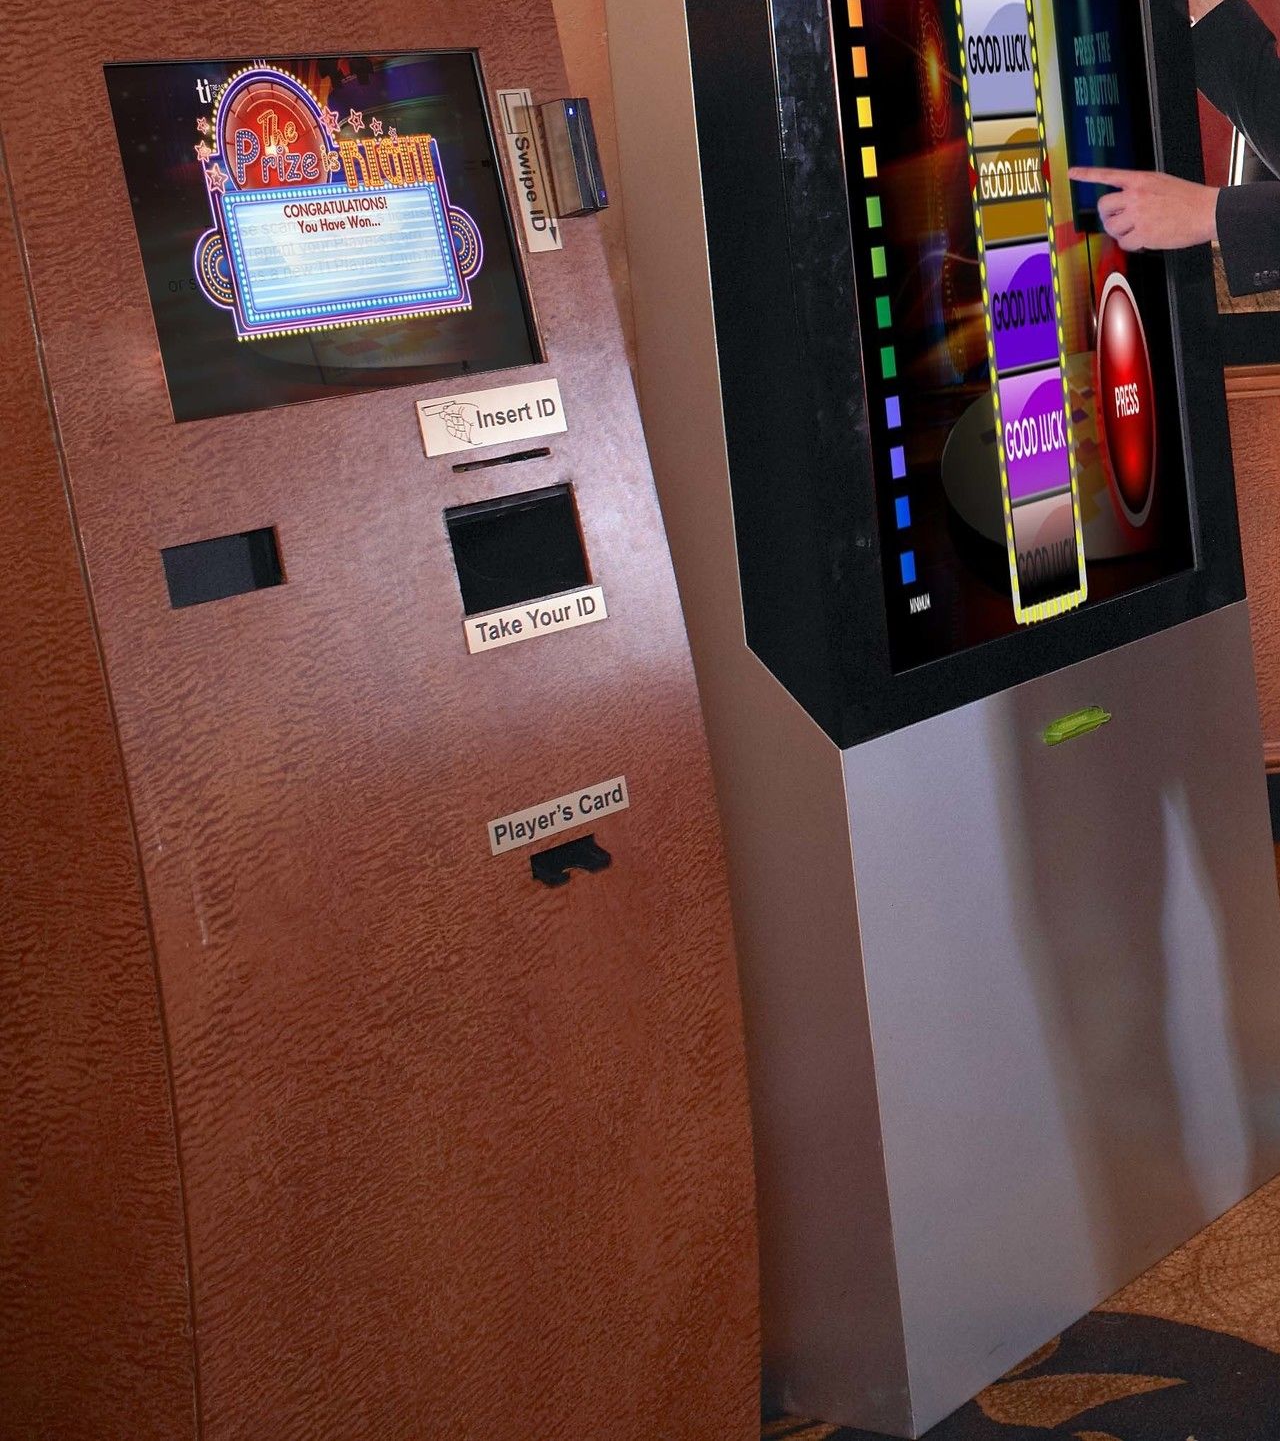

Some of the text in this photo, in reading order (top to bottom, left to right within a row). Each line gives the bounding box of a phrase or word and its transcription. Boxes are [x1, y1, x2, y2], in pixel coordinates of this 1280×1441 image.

[968, 34, 1030, 75] GOOD LUCK
[1074, 31, 1112, 67] PRESS THE
[1074, 73, 1120, 106] RED BUTTON
[257, 110, 299, 147] The
[1085, 115, 1116, 147] TO SPIN
[234, 128, 436, 189] Prize is RIGHT
[979, 157, 1042, 199] GOOD LUCK
[514, 136, 547, 232] Swipe ID
[283, 197, 388, 219] CONGRATULATIONS!
[297, 215, 381, 234] You Have Won...
[993, 285, 1055, 331] GOOD LUCK
[476, 398, 556, 429] Insert ID
[1114, 382, 1140, 418] PRESS
[1004, 410, 1066, 462] GOOD LUCK
[475, 596, 596, 643] Take Your ID
[494, 783, 624, 846] Player's Card
